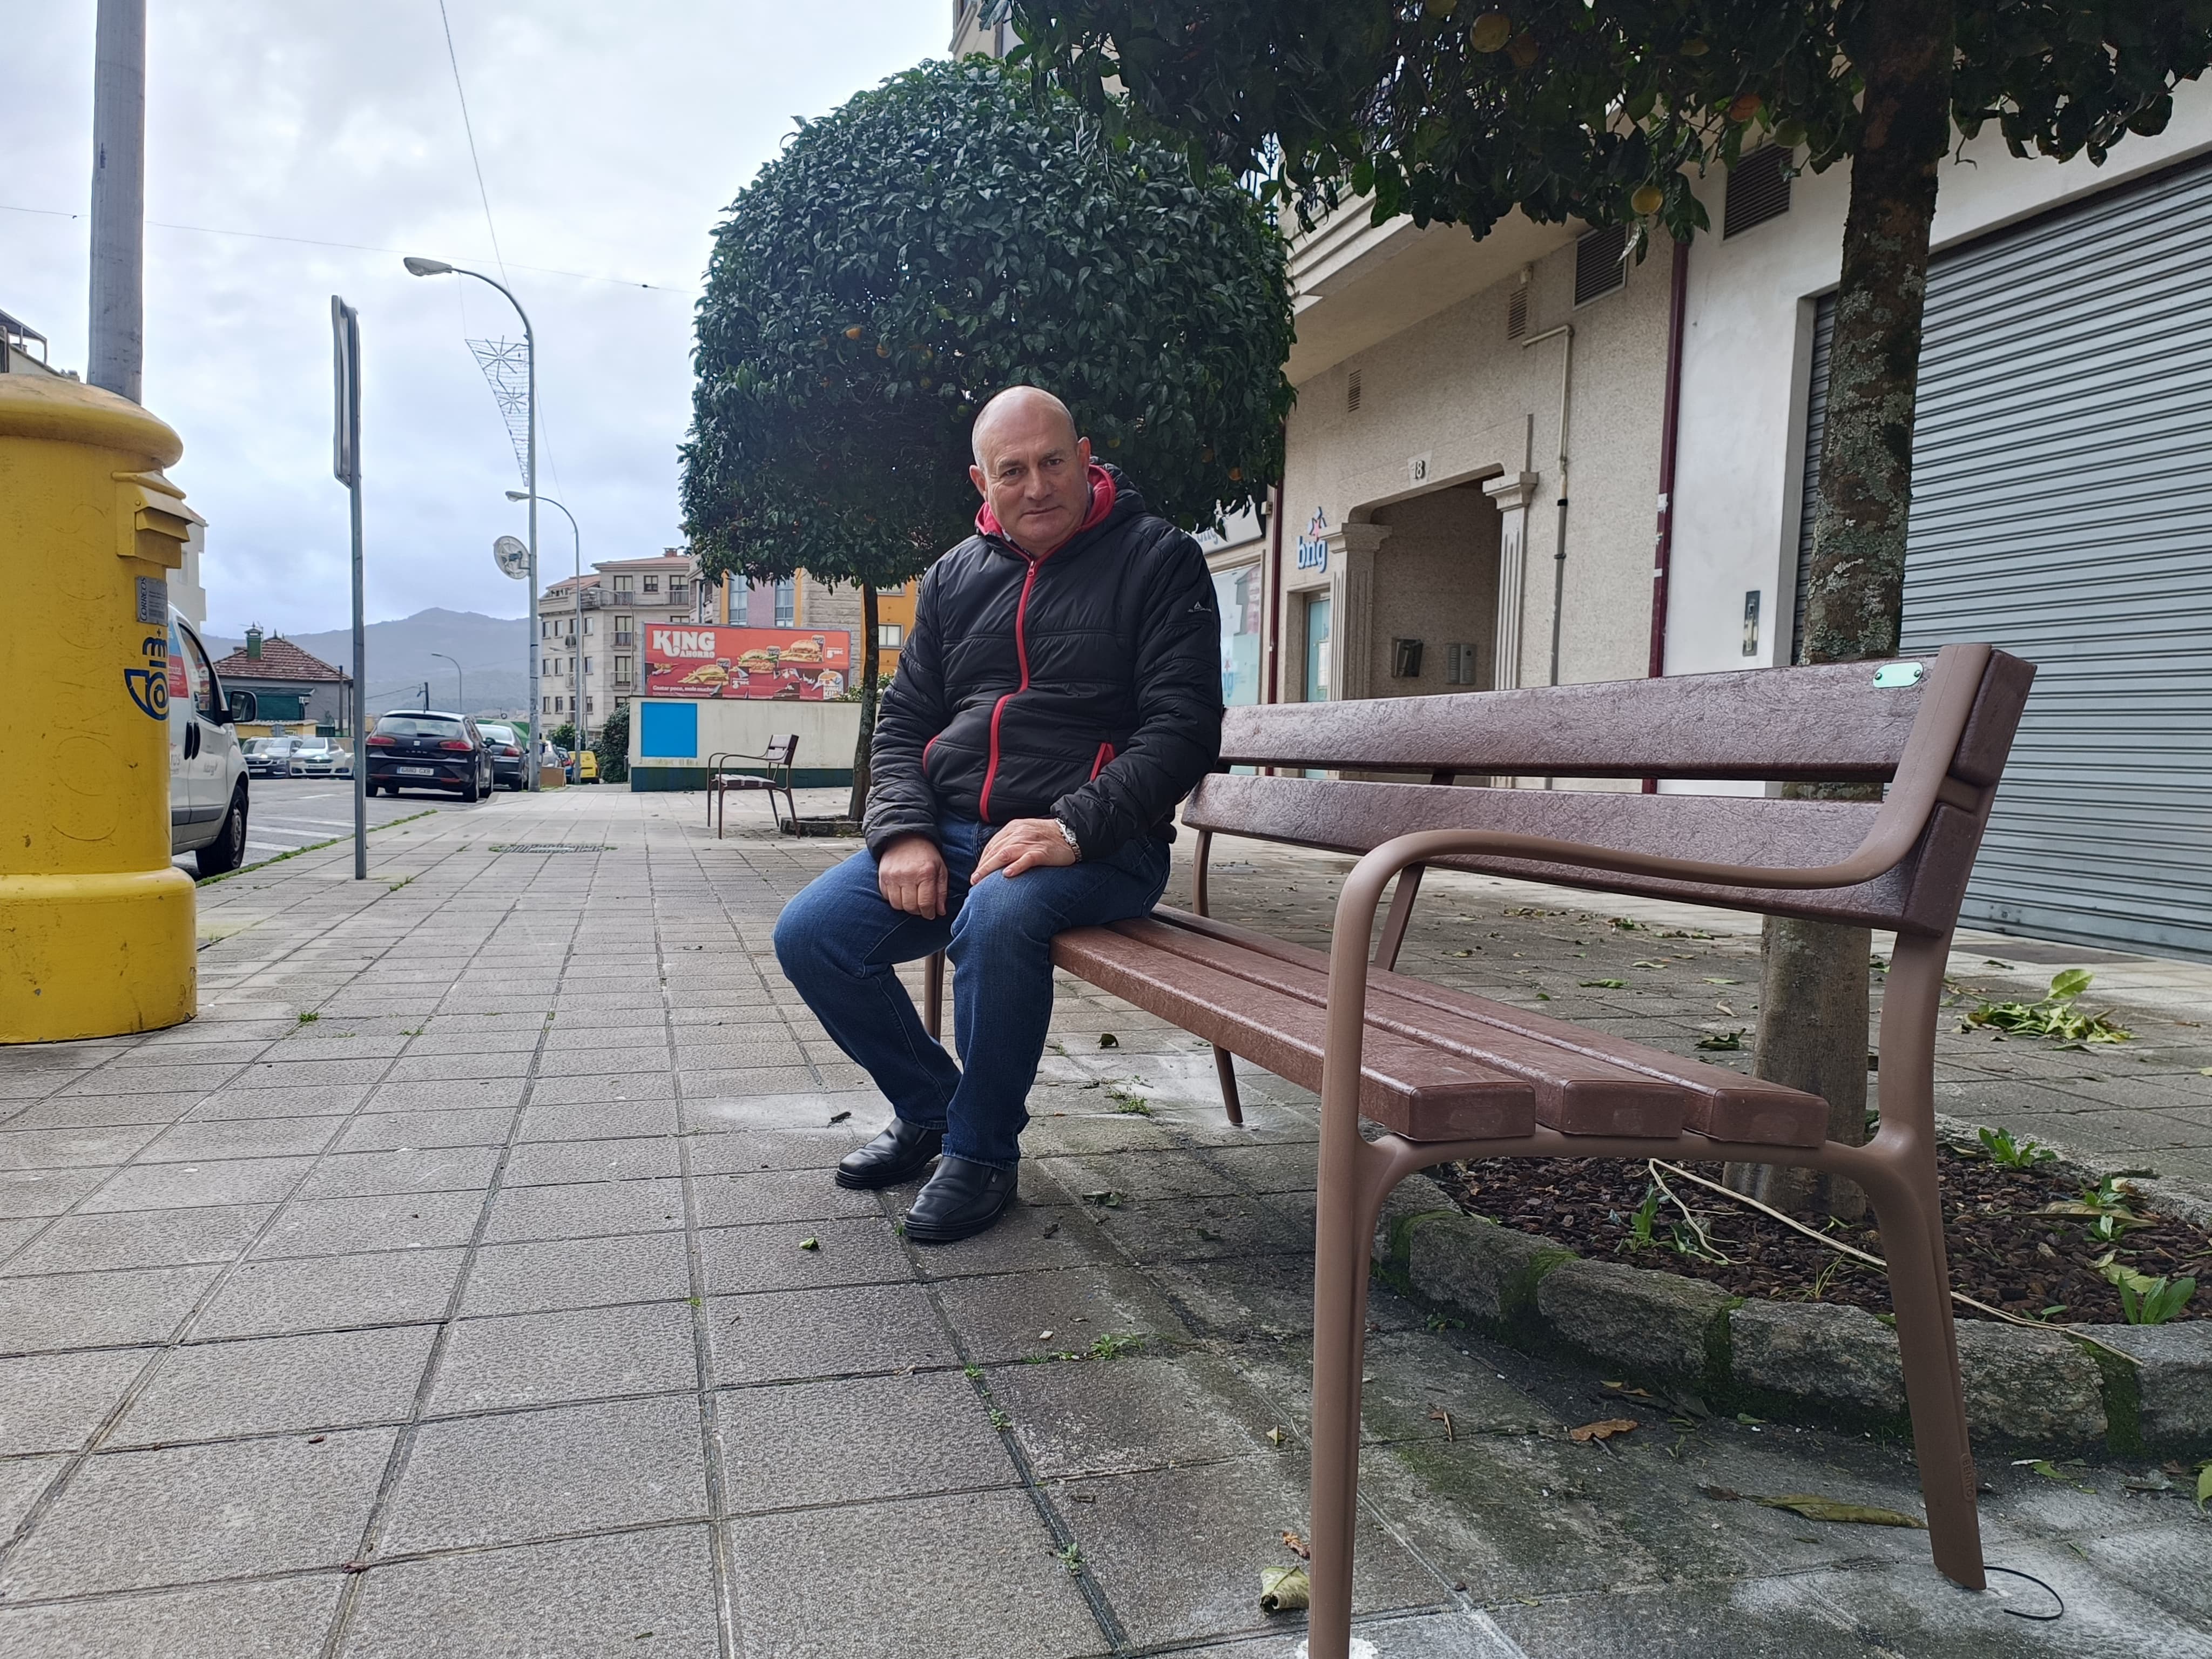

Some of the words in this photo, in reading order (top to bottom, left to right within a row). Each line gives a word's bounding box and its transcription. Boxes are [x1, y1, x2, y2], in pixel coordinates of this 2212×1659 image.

[1410, 460, 1426, 480] 18
[1298, 536, 1328, 574] bng
[652, 630, 715, 657] KING
[679, 650, 715, 658] AHORRO
[1963, 1459, 1974, 1498] BENITO
